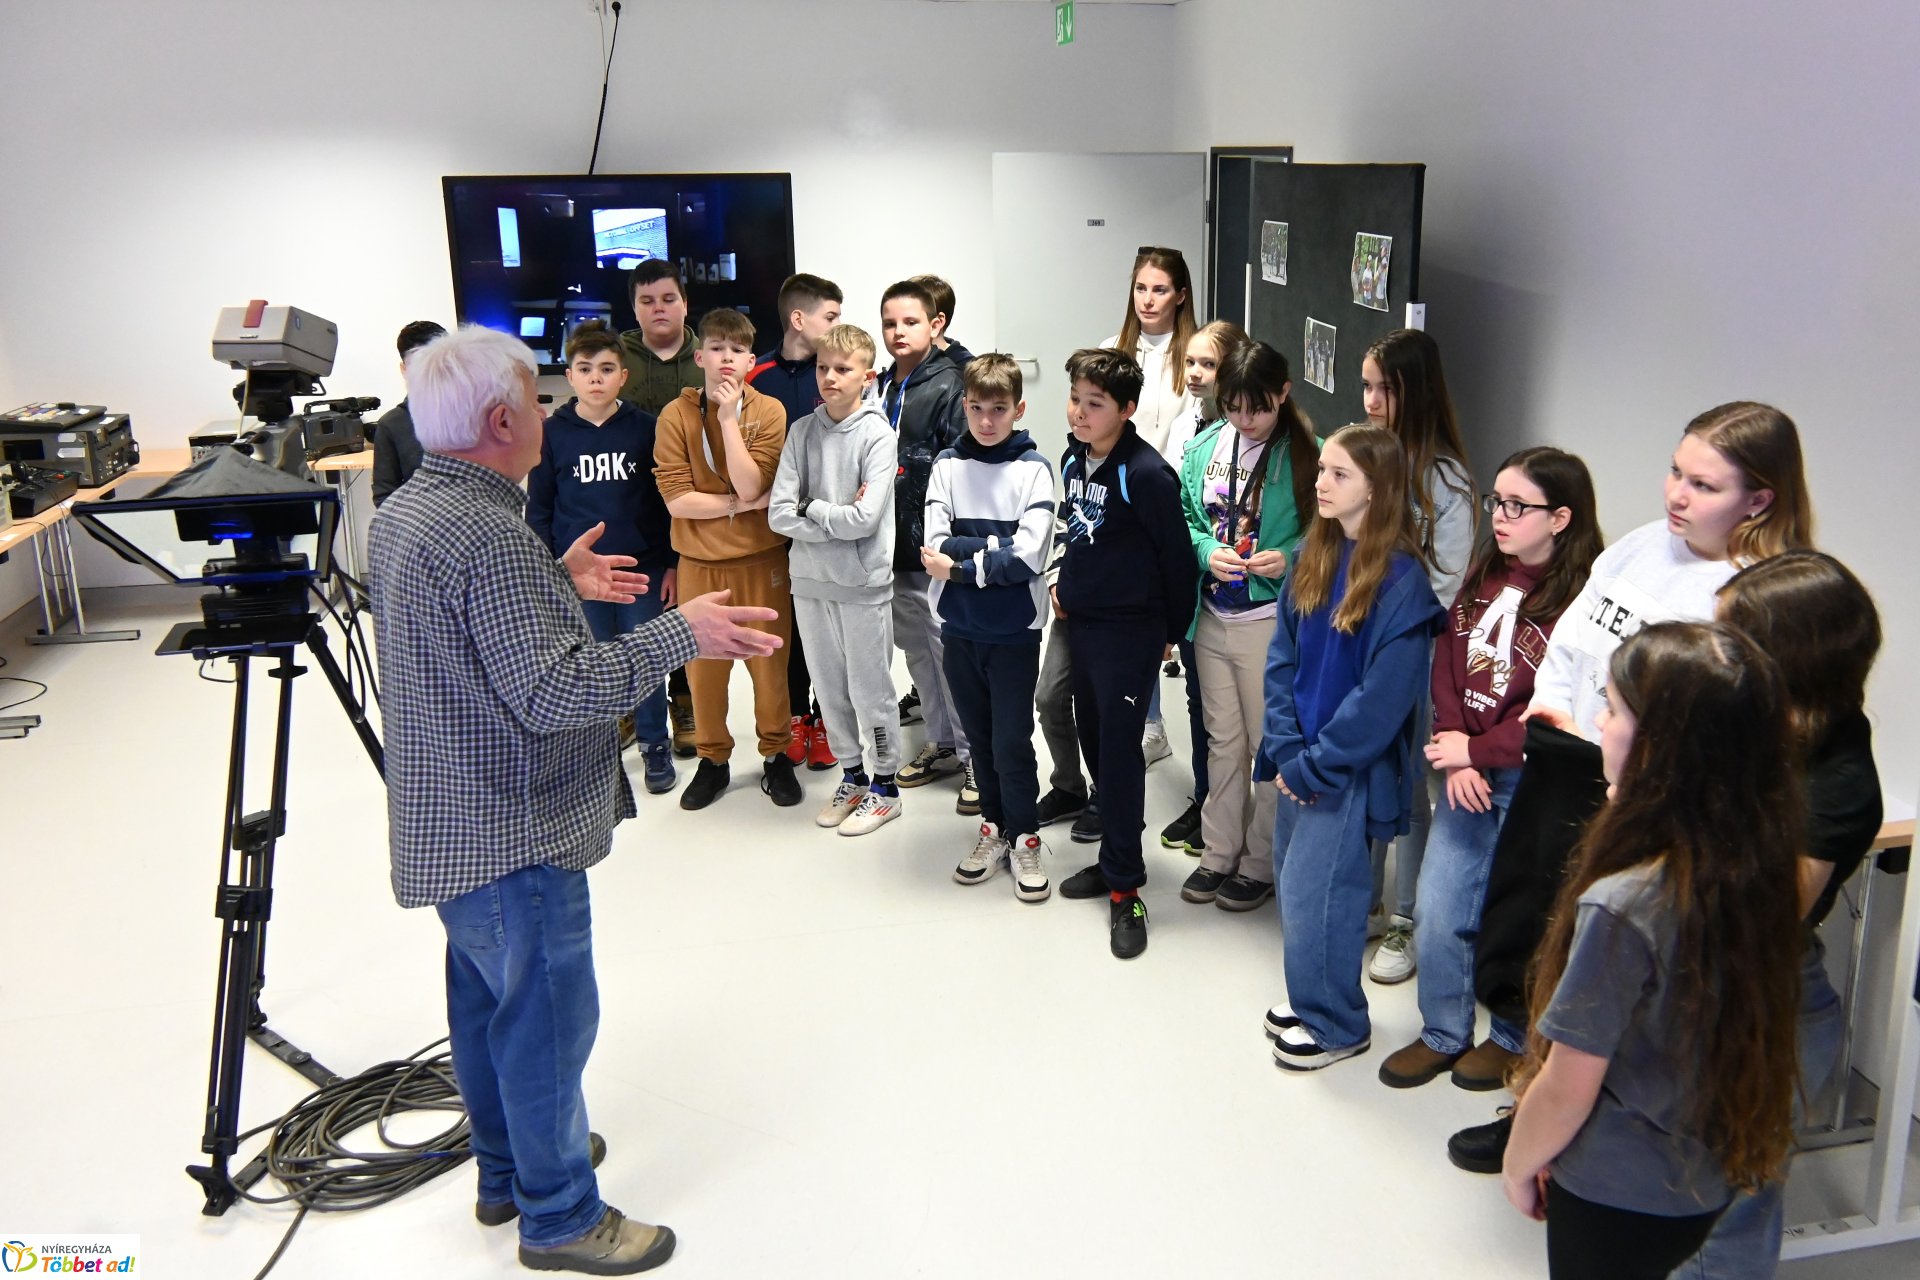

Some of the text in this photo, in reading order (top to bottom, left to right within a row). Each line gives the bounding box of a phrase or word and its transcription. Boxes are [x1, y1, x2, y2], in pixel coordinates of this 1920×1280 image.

[1069, 478, 1108, 505] PUMA
[1467, 699, 1486, 713] LIFE
[1472, 691, 1497, 708] VIBES
